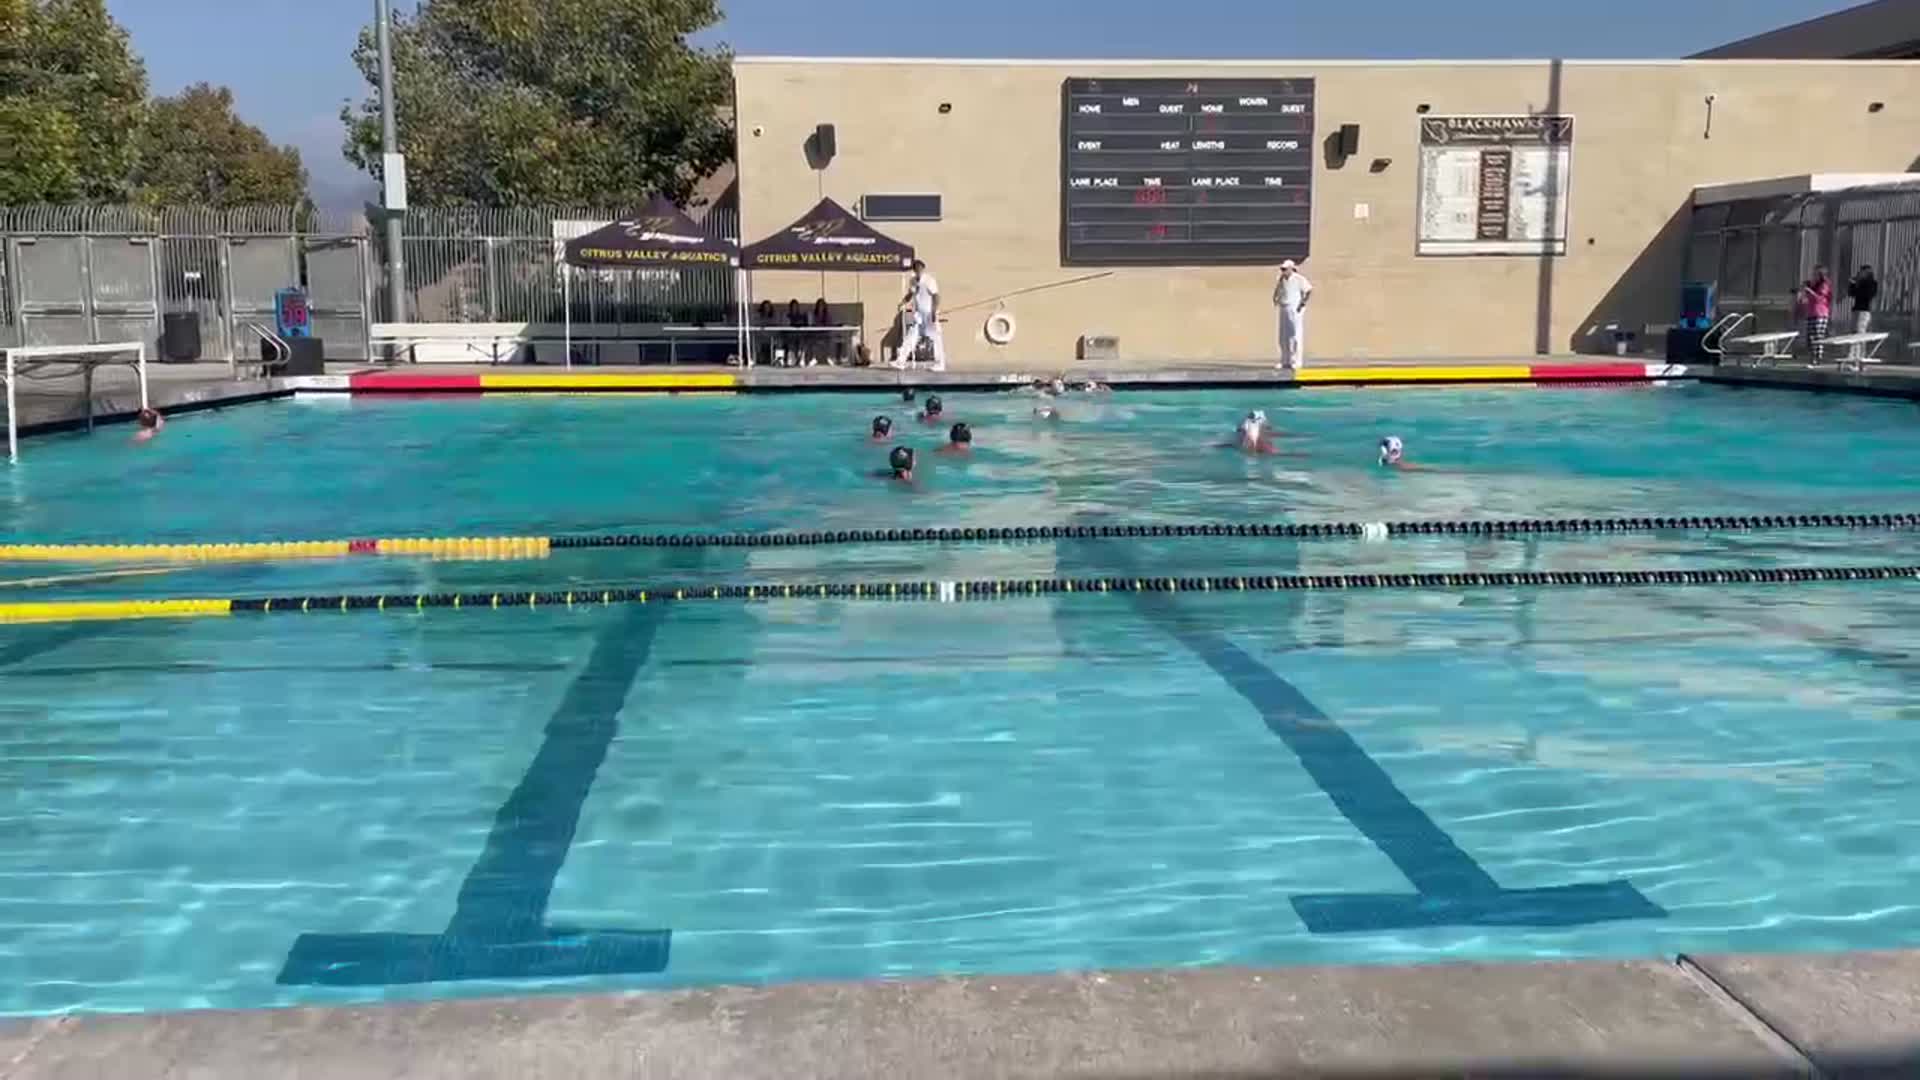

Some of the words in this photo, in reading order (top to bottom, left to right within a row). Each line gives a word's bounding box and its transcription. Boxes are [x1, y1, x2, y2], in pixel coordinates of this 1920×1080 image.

[1122, 97, 1140, 106] MEN
[1238, 97, 1268, 106] WOMEN
[1078, 104, 1101, 113] HOME
[1158, 104, 1184, 113] GUEST
[1200, 104, 1224, 113] HOME
[1281, 104, 1306, 113] GUEST
[1447, 118, 1545, 131] BLACKHAWKS
[1077, 141, 1101, 150] EVENT
[1160, 141, 1181, 150] HEAT
[1192, 141, 1225, 150] LENGTHS
[1266, 140, 1298, 150] RECORD
[1070, 177, 1091, 187] LANE
[1094, 177, 1118, 187] PLACE
[1143, 177, 1162, 186] TIME
[1191, 177, 1212, 187] LANE
[1215, 177, 1240, 187] PLACE
[1264, 177, 1283, 186] TIME
[580, 248, 622, 258] CITRUS
[626, 249, 667, 260] VALLEY
[671, 251, 727, 263] AQUATICS
[757, 252, 799, 264] CITRUS
[801, 252, 843, 263] VALLEY
[846, 253, 901, 264] AQUATICS
